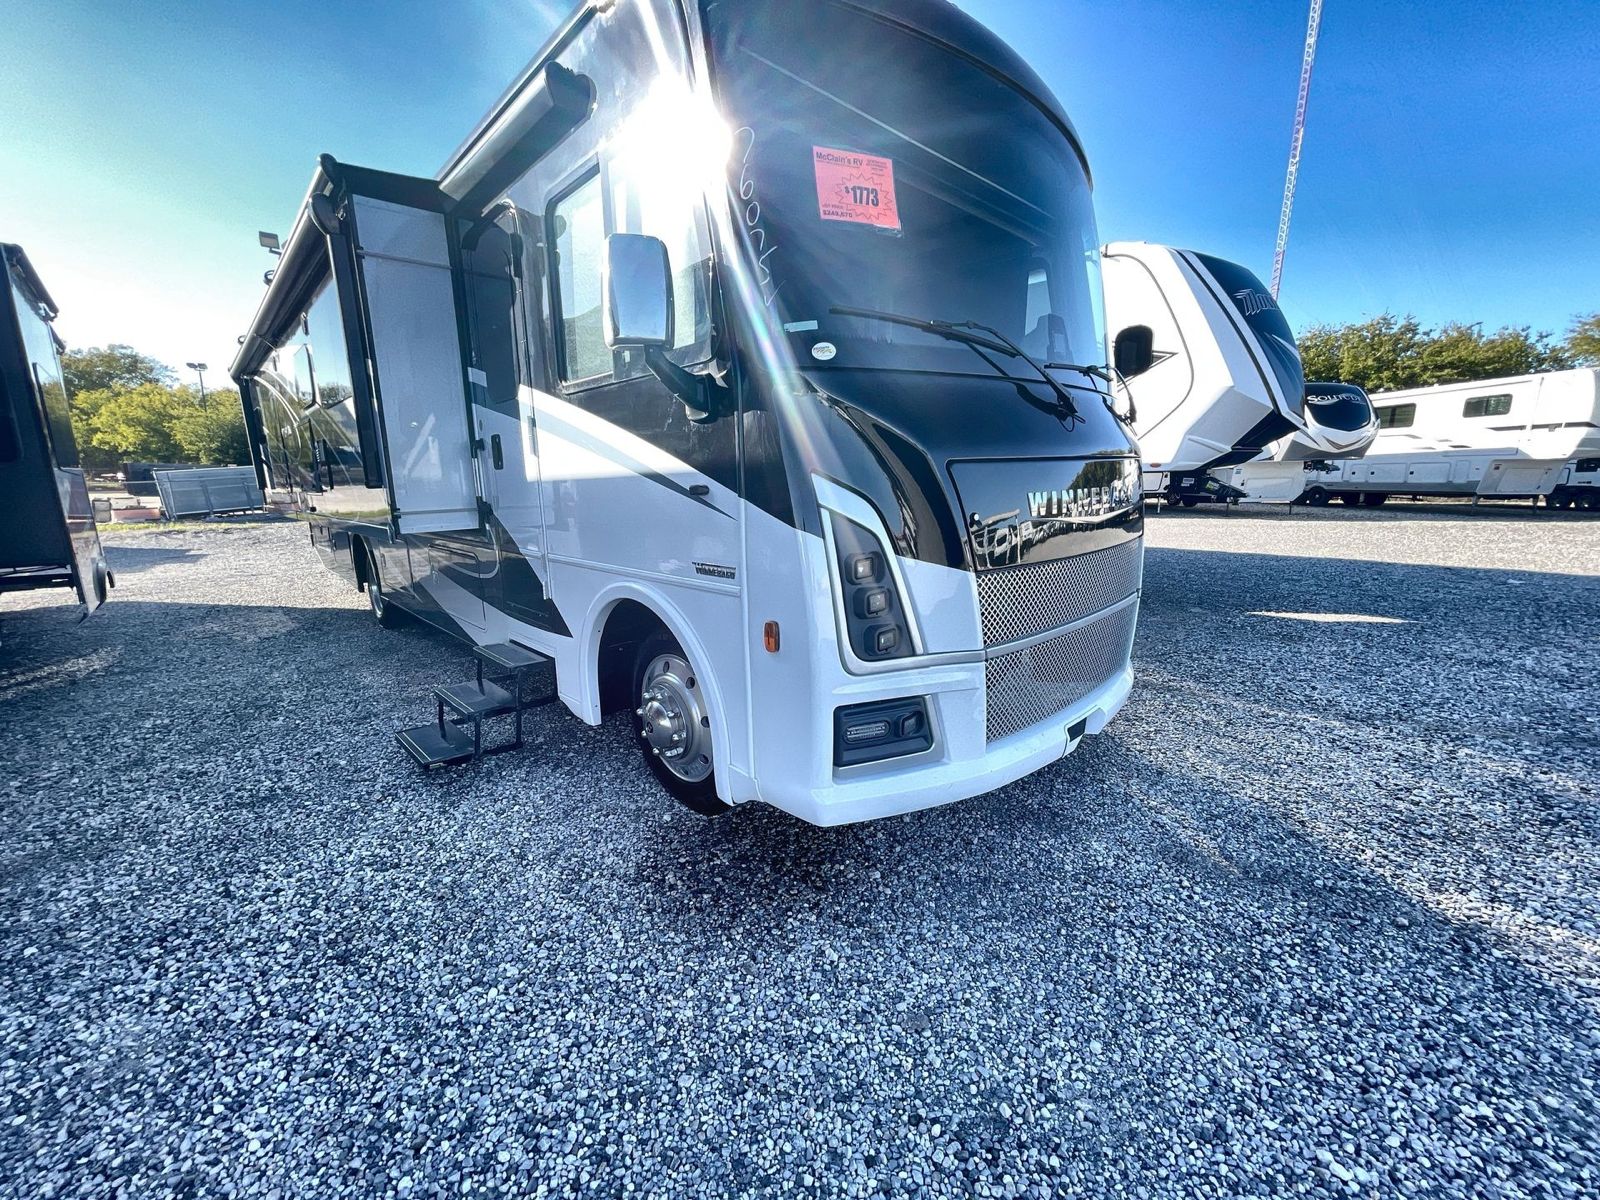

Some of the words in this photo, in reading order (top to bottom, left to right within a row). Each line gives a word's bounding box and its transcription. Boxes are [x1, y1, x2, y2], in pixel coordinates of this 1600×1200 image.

[816, 151, 852, 164] McClain's
[853, 157, 863, 166] RV
[844, 185, 880, 207] $1773
